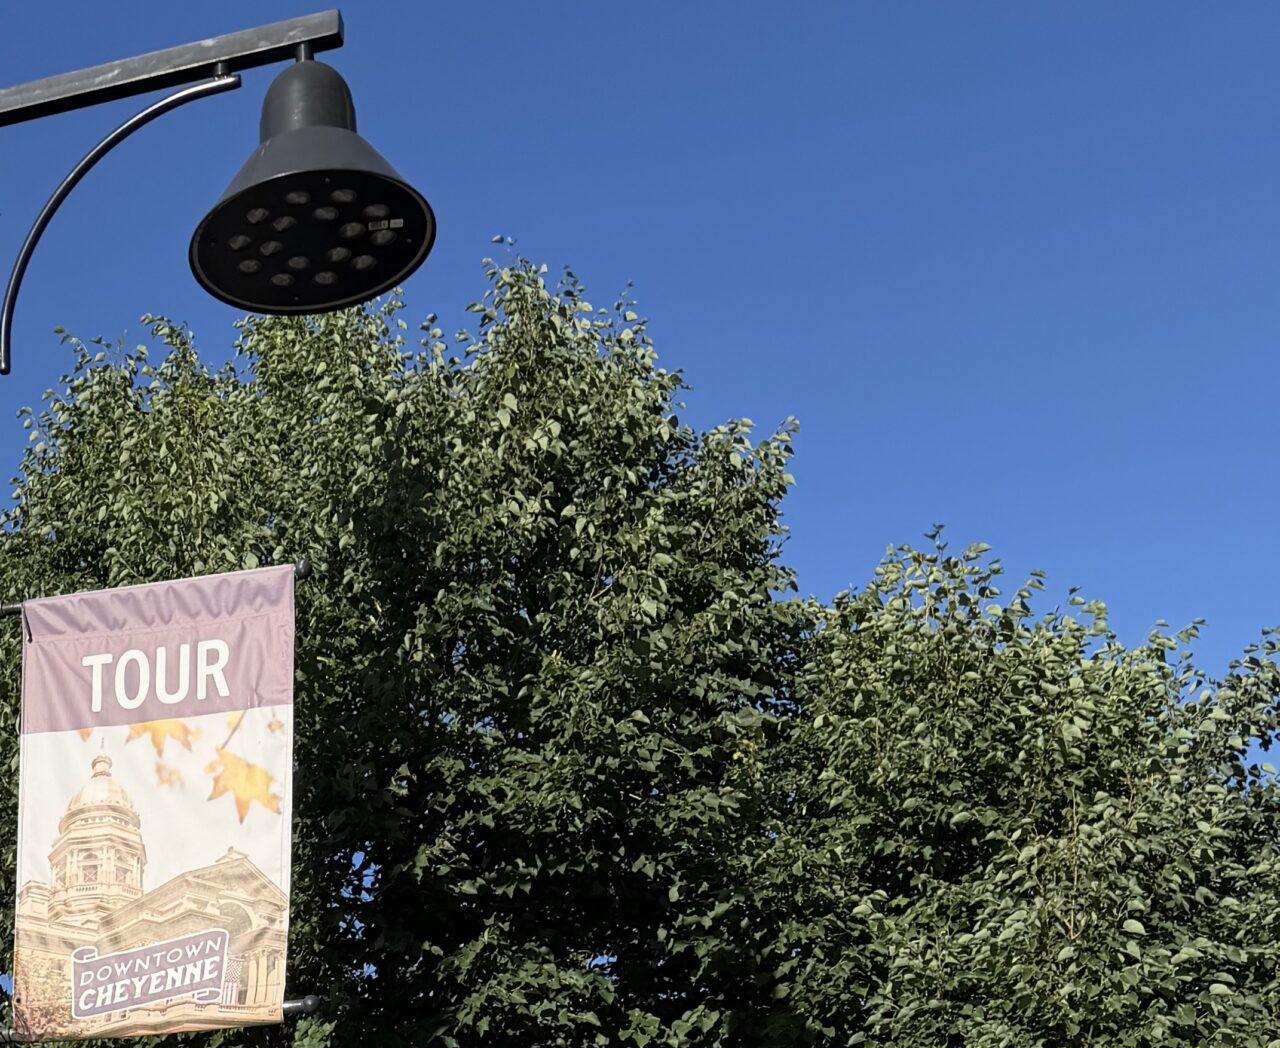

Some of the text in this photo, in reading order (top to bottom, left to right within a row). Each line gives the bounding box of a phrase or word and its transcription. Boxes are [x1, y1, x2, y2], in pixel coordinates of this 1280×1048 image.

[82, 639, 230, 712] TOUR
[78, 955, 221, 1011] CHEYENNE
[79, 937, 222, 986] DOWNTOWN
